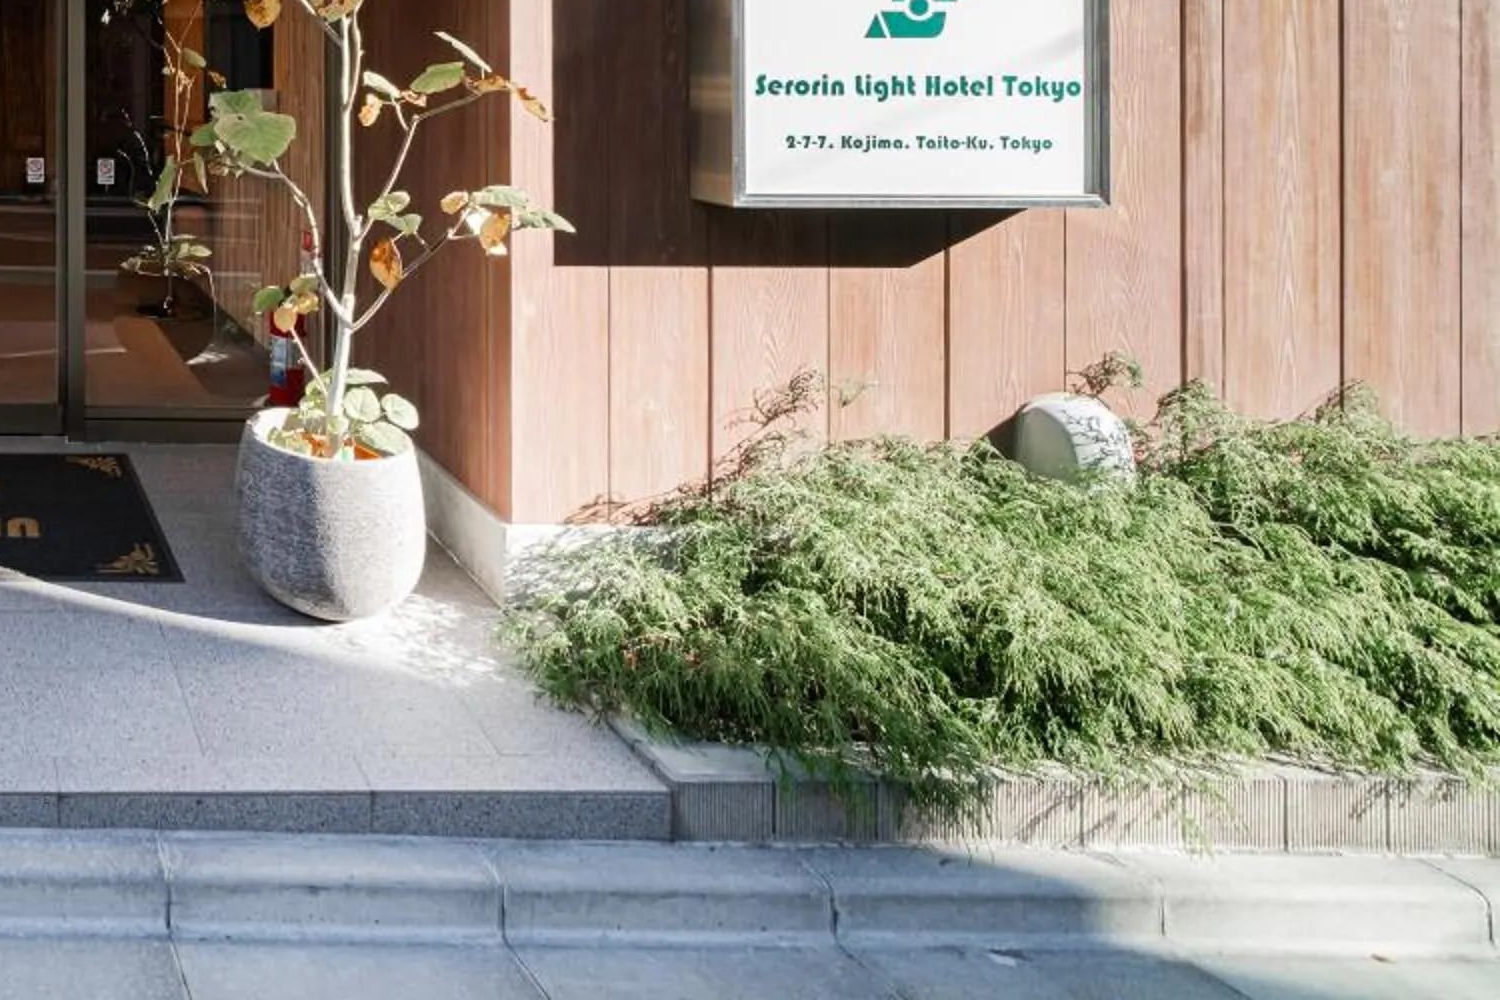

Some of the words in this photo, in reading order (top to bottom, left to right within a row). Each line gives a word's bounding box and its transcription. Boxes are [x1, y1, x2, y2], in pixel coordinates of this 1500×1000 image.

[755, 73, 845, 96] Serorin
[855, 73, 917, 103] Light
[925, 75, 993, 97] Hotel
[1002, 75, 1082, 103] Tokyo
[1000, 135, 1054, 154] Tokyo
